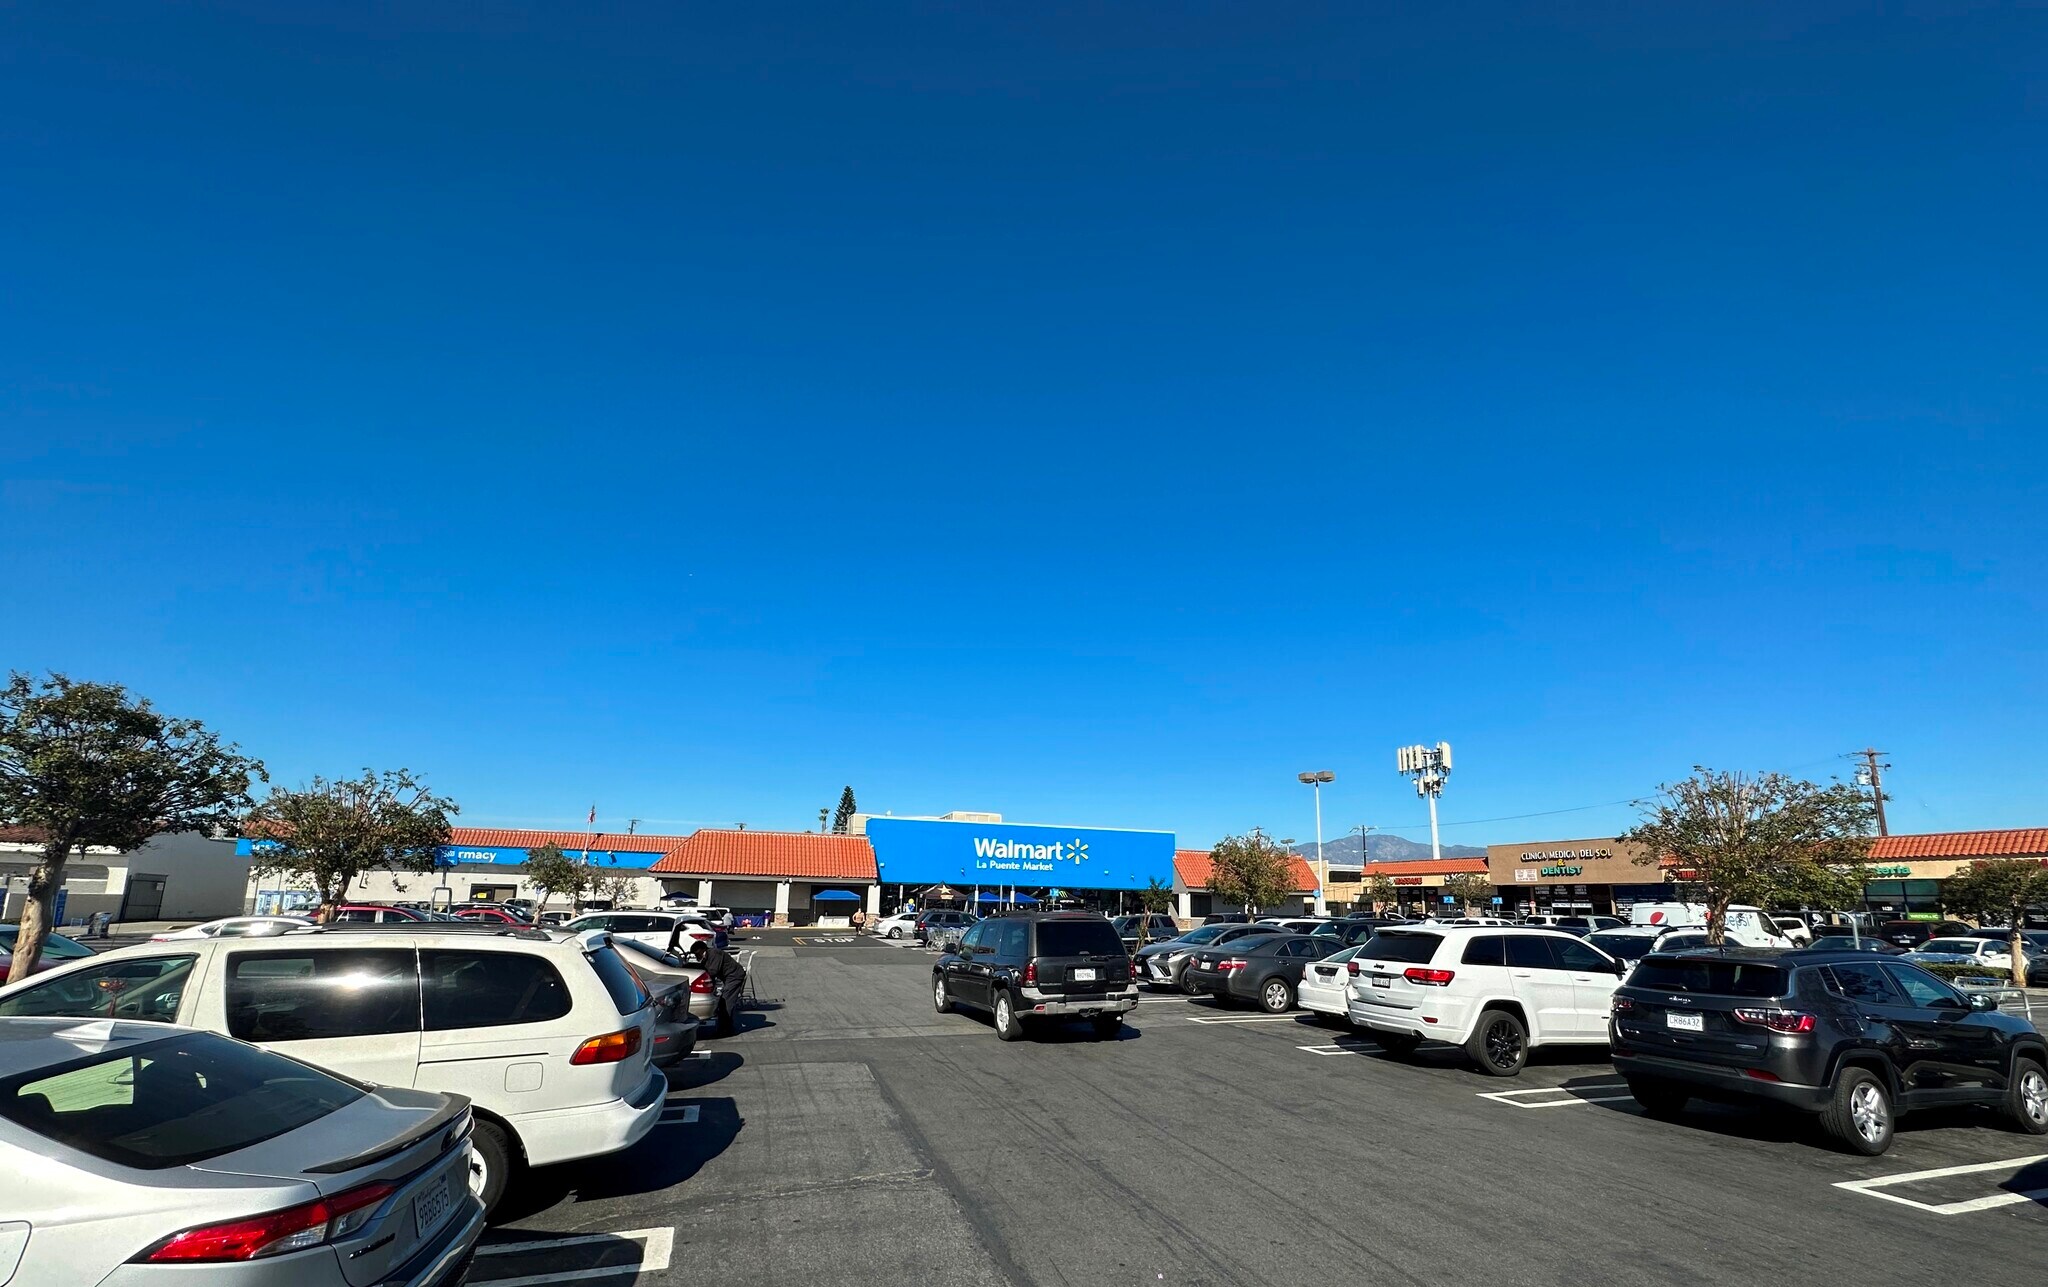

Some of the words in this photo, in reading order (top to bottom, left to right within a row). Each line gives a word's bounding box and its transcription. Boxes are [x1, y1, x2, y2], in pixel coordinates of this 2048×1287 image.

[974, 838, 1063, 860] Walmart
[1521, 852, 1547, 861] CLINICA
[1549, 850, 1576, 860] MEDICA
[1580, 849, 1594, 858] DEL
[1596, 848, 1612, 858] SOL
[458, 851, 497, 862] rmacy
[976, 860, 987, 869] La
[990, 860, 1020, 870] Puente
[1022, 862, 1053, 871] Market
[1541, 866, 1582, 876] DENTIST
[419, 1187, 449, 1229] 9BBG575
